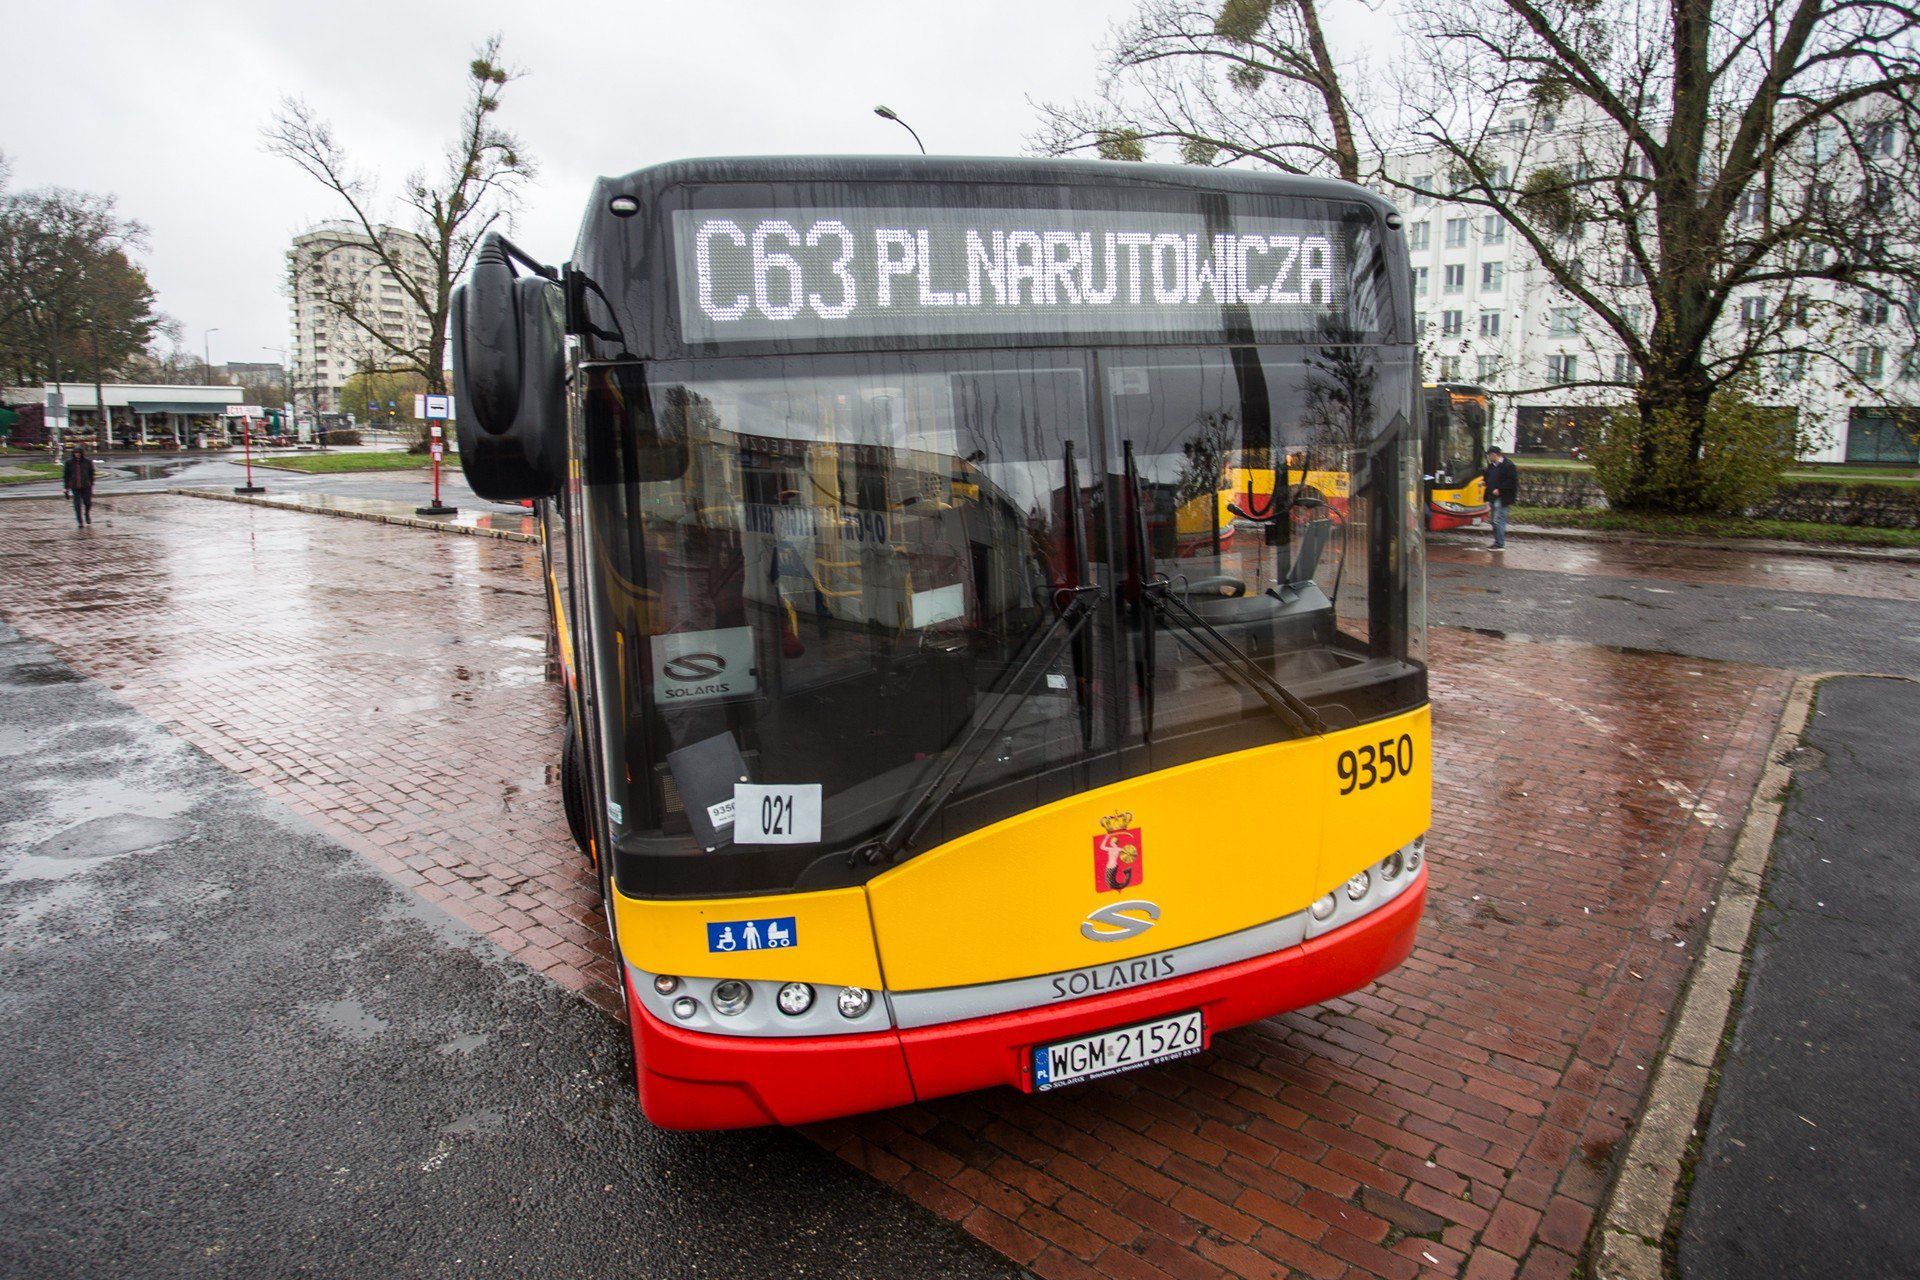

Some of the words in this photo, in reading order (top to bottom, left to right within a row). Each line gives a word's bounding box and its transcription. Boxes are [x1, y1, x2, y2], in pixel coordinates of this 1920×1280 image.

[695, 219, 857, 321] C63
[664, 683, 730, 699] SOLARIS
[1337, 733, 1413, 796] 9350
[761, 795, 793, 835] 021
[1052, 954, 1175, 999] SOLARIS
[1051, 1038, 1106, 1078] WGM
[1115, 1016, 1198, 1063] 21526
[1037, 1069, 1048, 1079] PL
